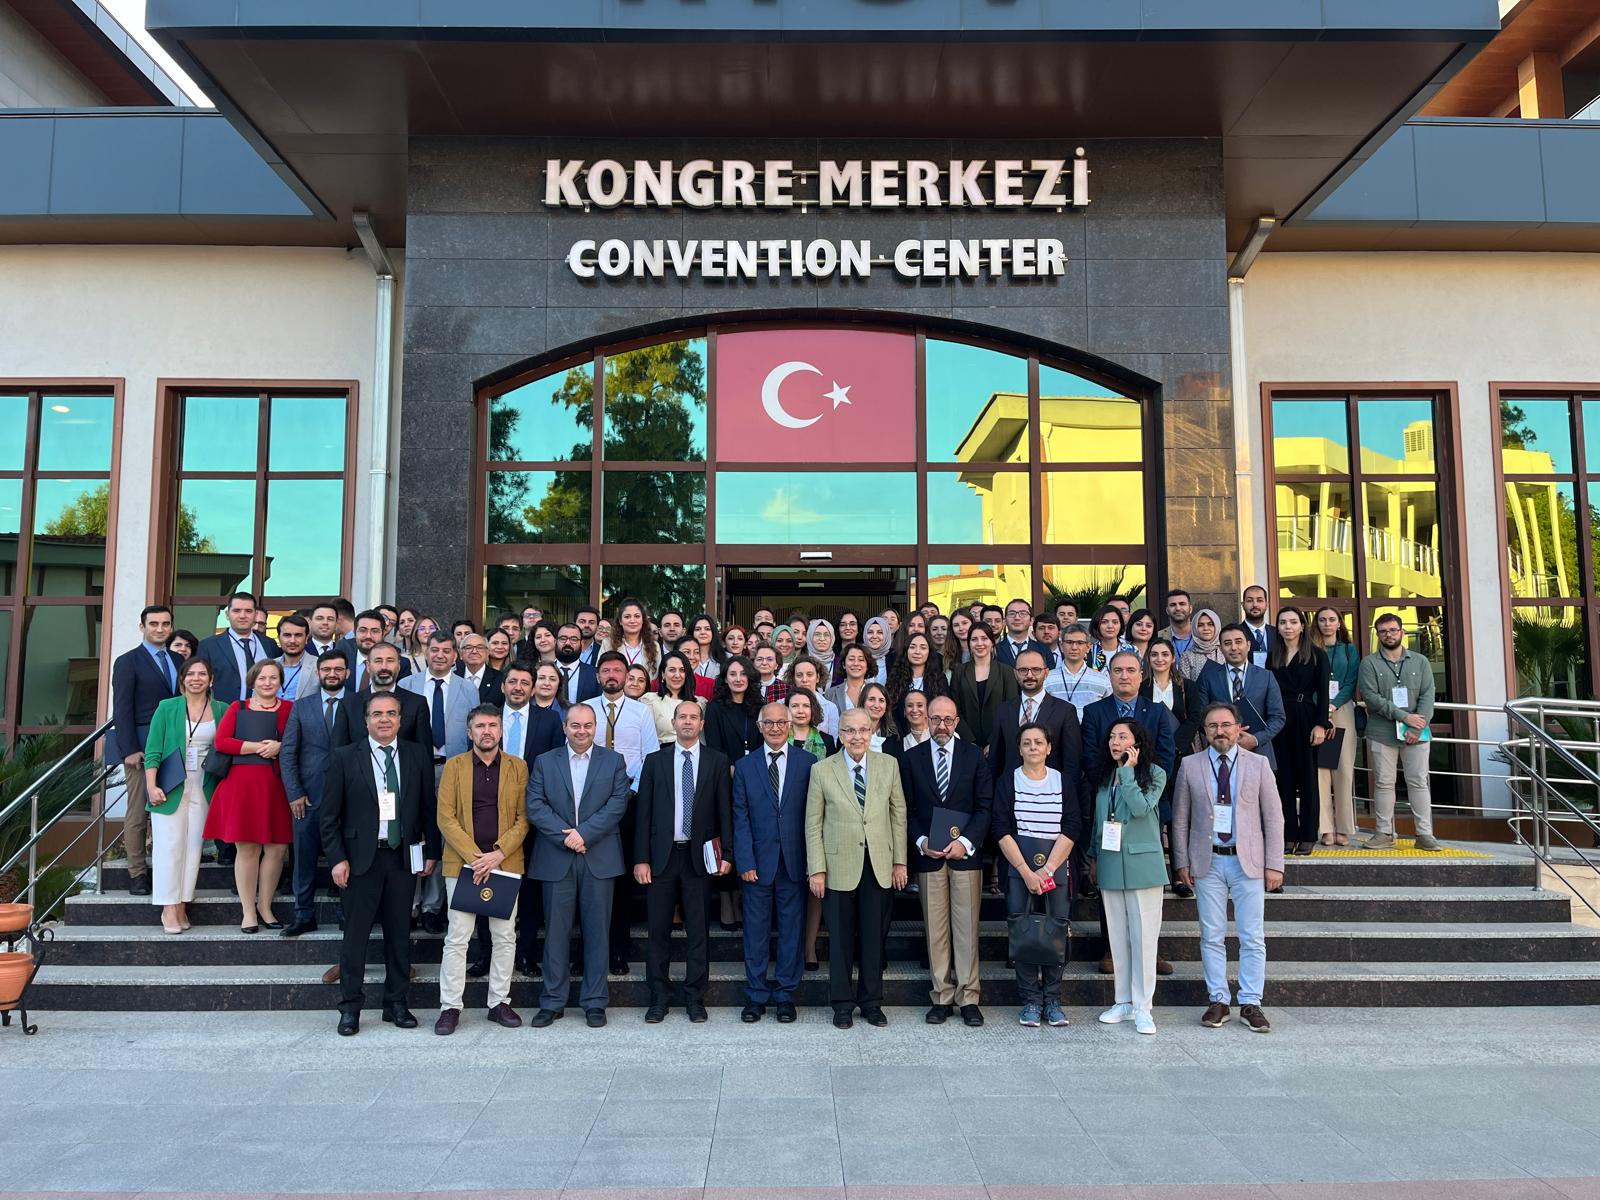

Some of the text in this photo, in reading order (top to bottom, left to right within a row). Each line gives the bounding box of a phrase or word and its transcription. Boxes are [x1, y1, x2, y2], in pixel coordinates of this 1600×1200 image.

[545, 147, 1088, 207] KONGRE MERKEZİ
[568, 239, 1065, 278] CONVENTION CENTER
